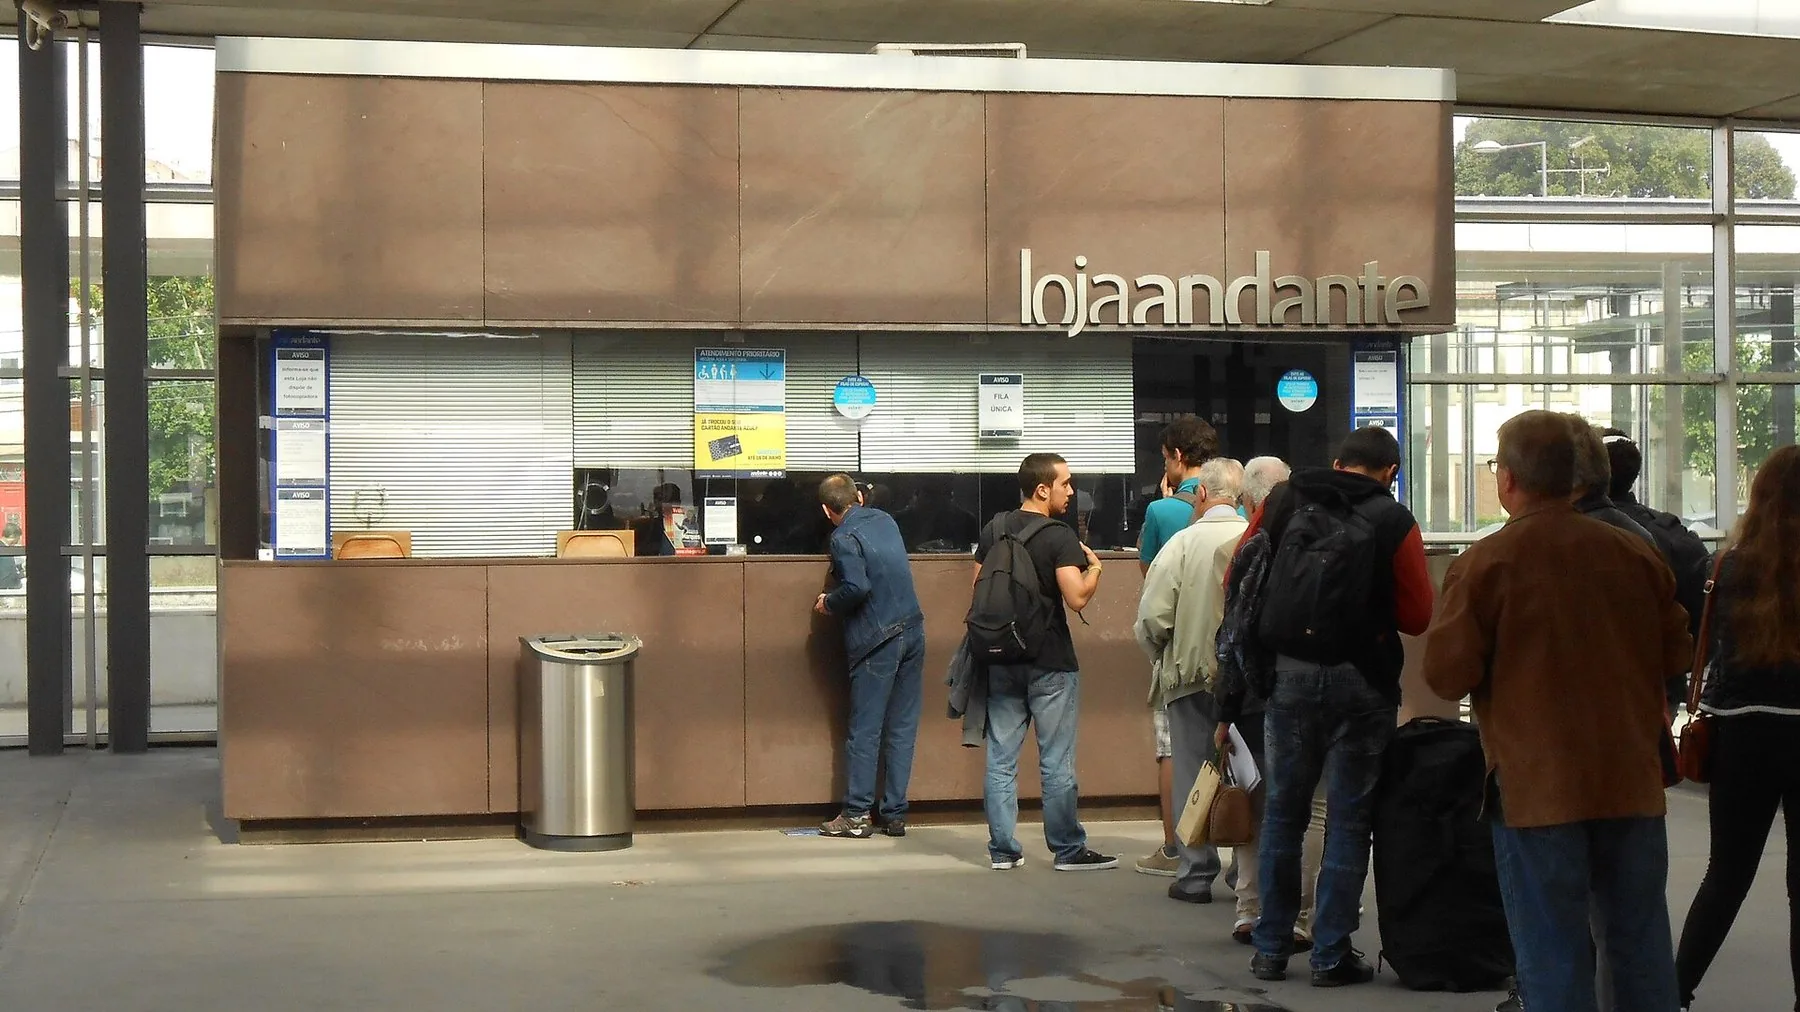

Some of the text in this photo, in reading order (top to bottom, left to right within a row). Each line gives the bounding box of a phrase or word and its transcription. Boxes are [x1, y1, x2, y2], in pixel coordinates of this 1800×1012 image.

[1021, 248, 1430, 337] lojaandante
[990, 404, 1012, 412] ÚNICA
[292, 491, 310, 499] AVISO
